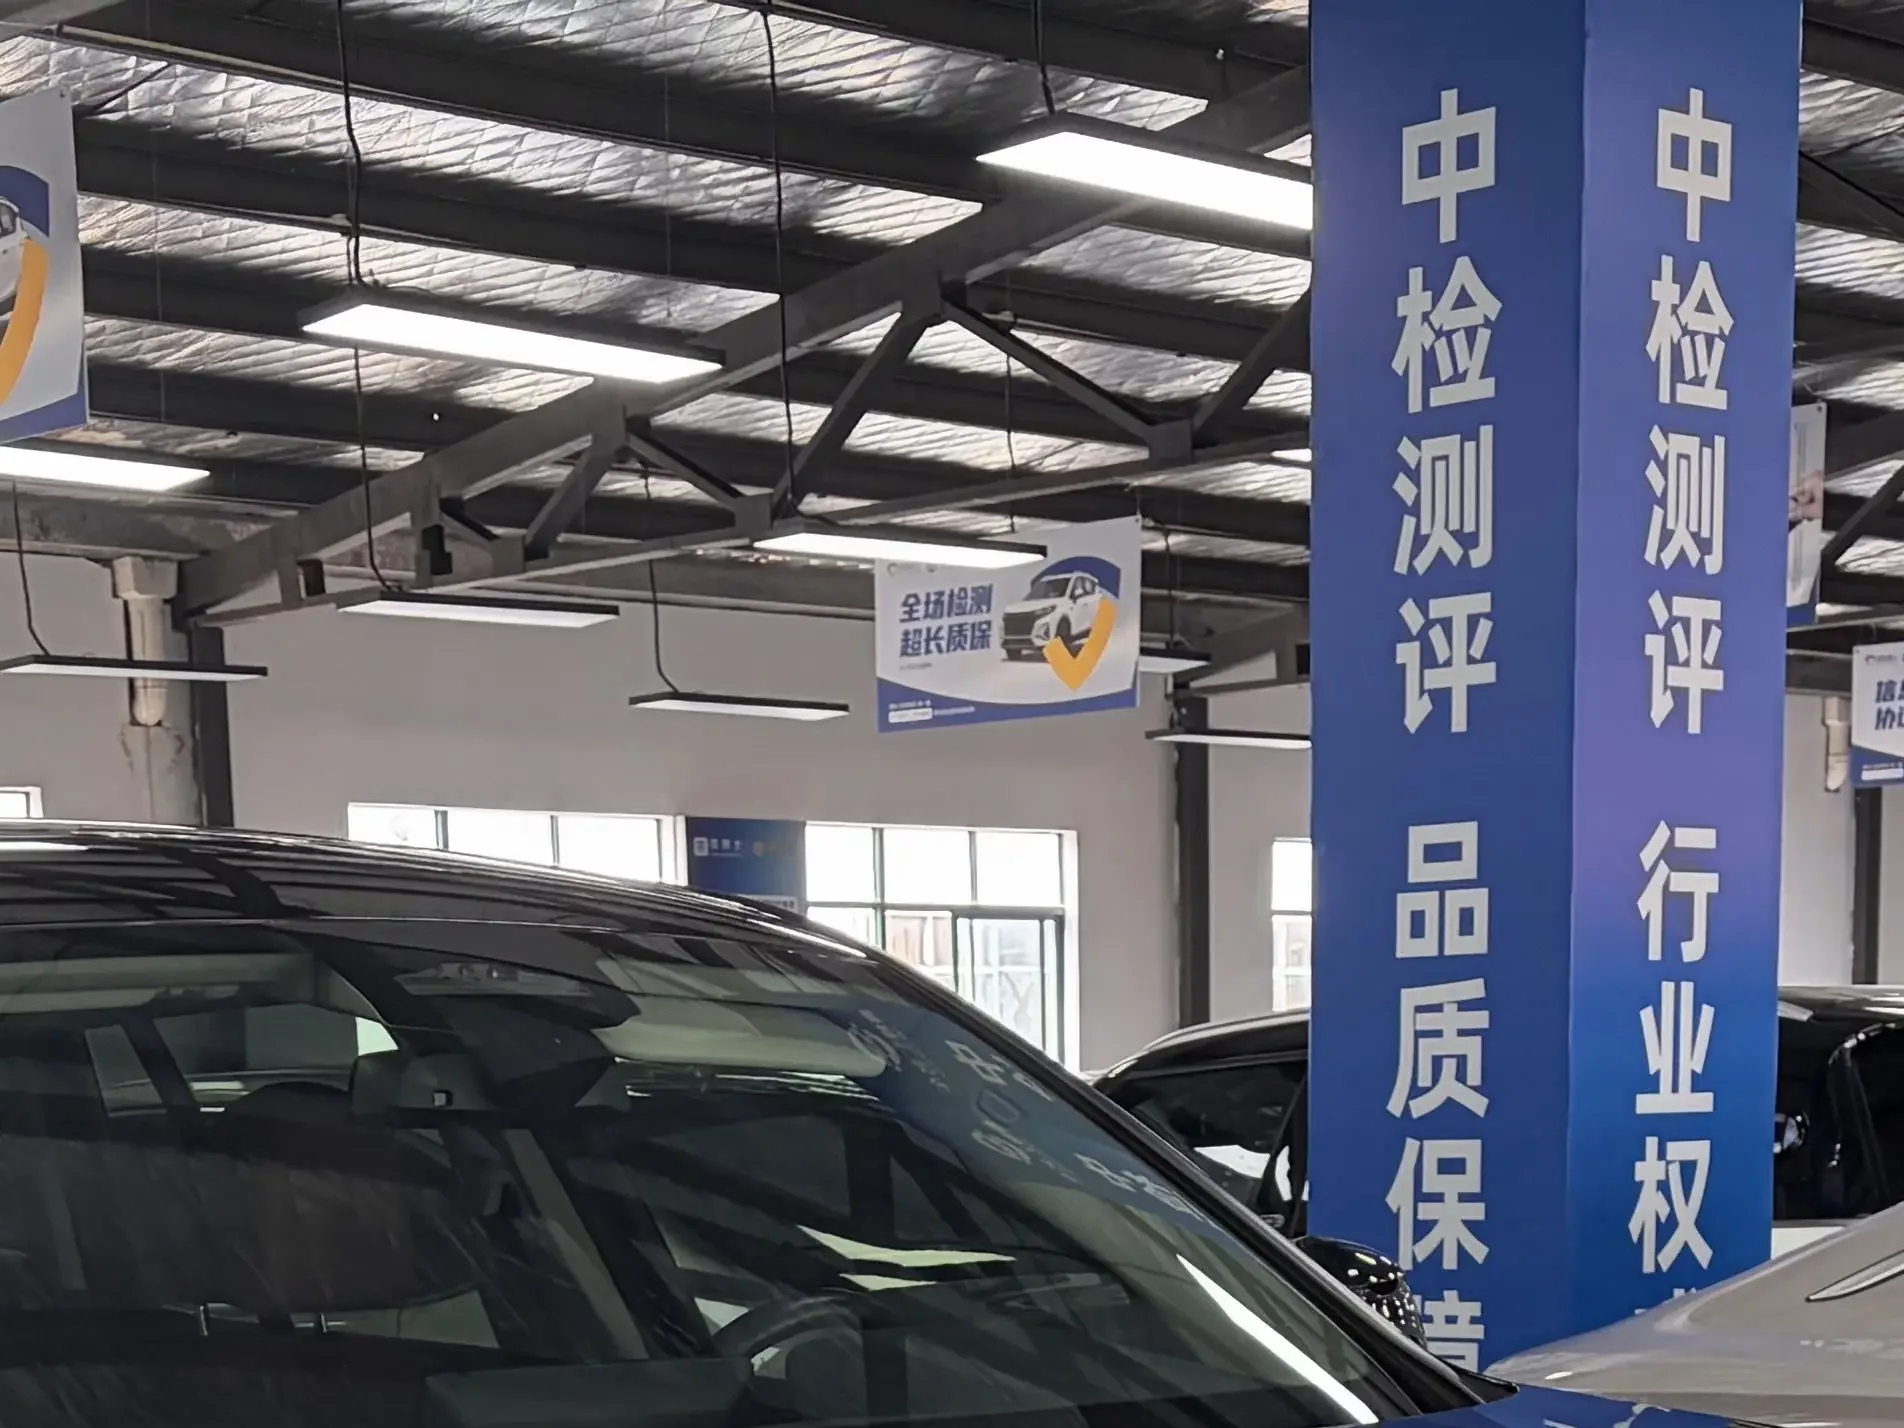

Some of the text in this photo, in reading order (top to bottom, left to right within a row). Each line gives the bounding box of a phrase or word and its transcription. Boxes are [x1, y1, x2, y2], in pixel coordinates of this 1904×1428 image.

[1391, 87, 1503, 734] 中检测评
[898, 583, 994, 623] 全场检测
[898, 619, 992, 658] 超长质保
[1628, 87, 1734, 1308] 中检测评 行业权
